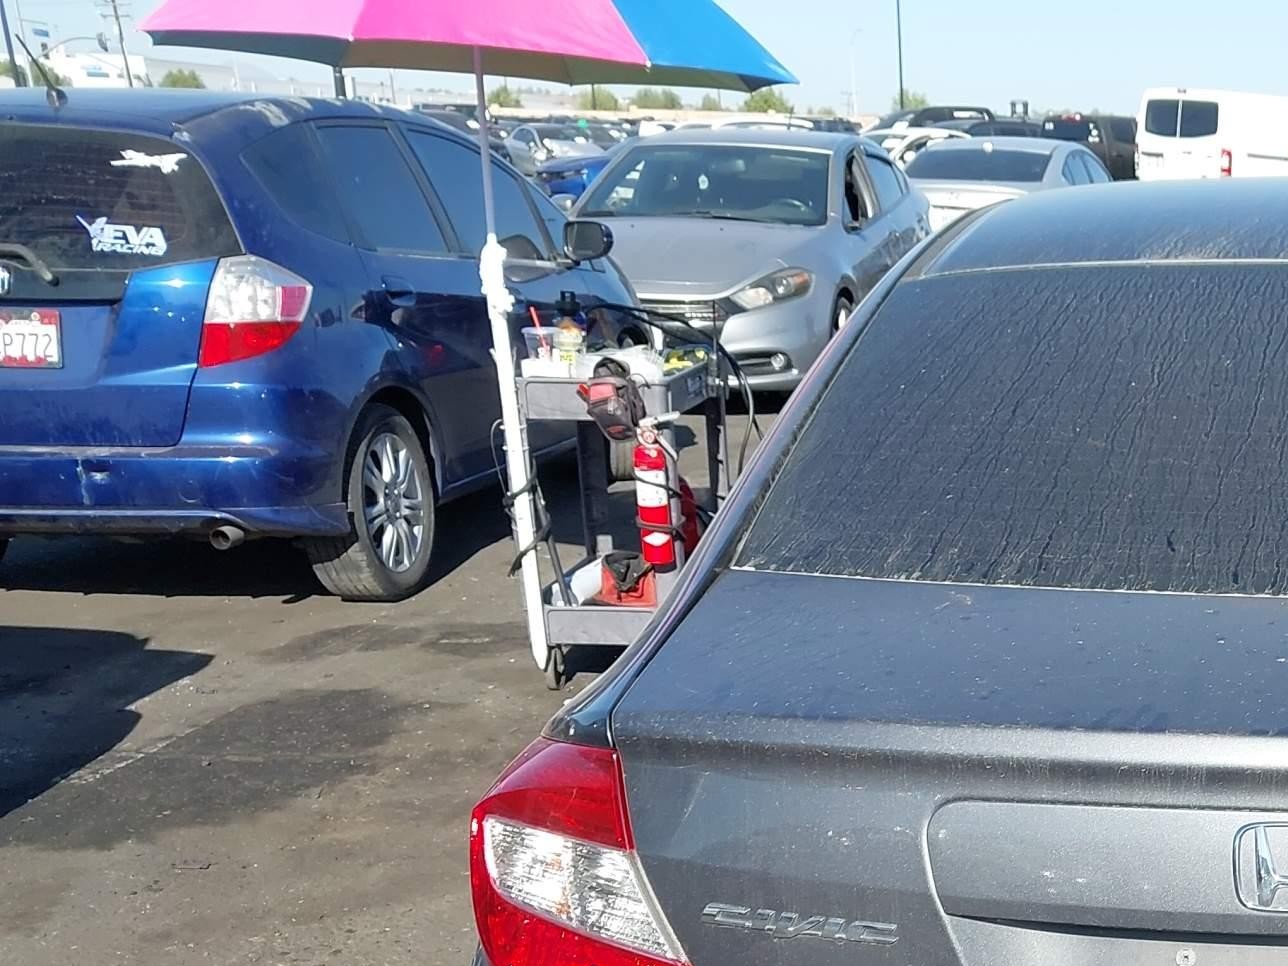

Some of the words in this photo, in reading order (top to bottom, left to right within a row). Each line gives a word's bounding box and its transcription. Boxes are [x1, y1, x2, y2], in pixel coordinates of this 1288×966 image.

[96, 242, 166, 255] RACING
[0, 332, 54, 358] P772
[701, 902, 899, 947] CIVIC
